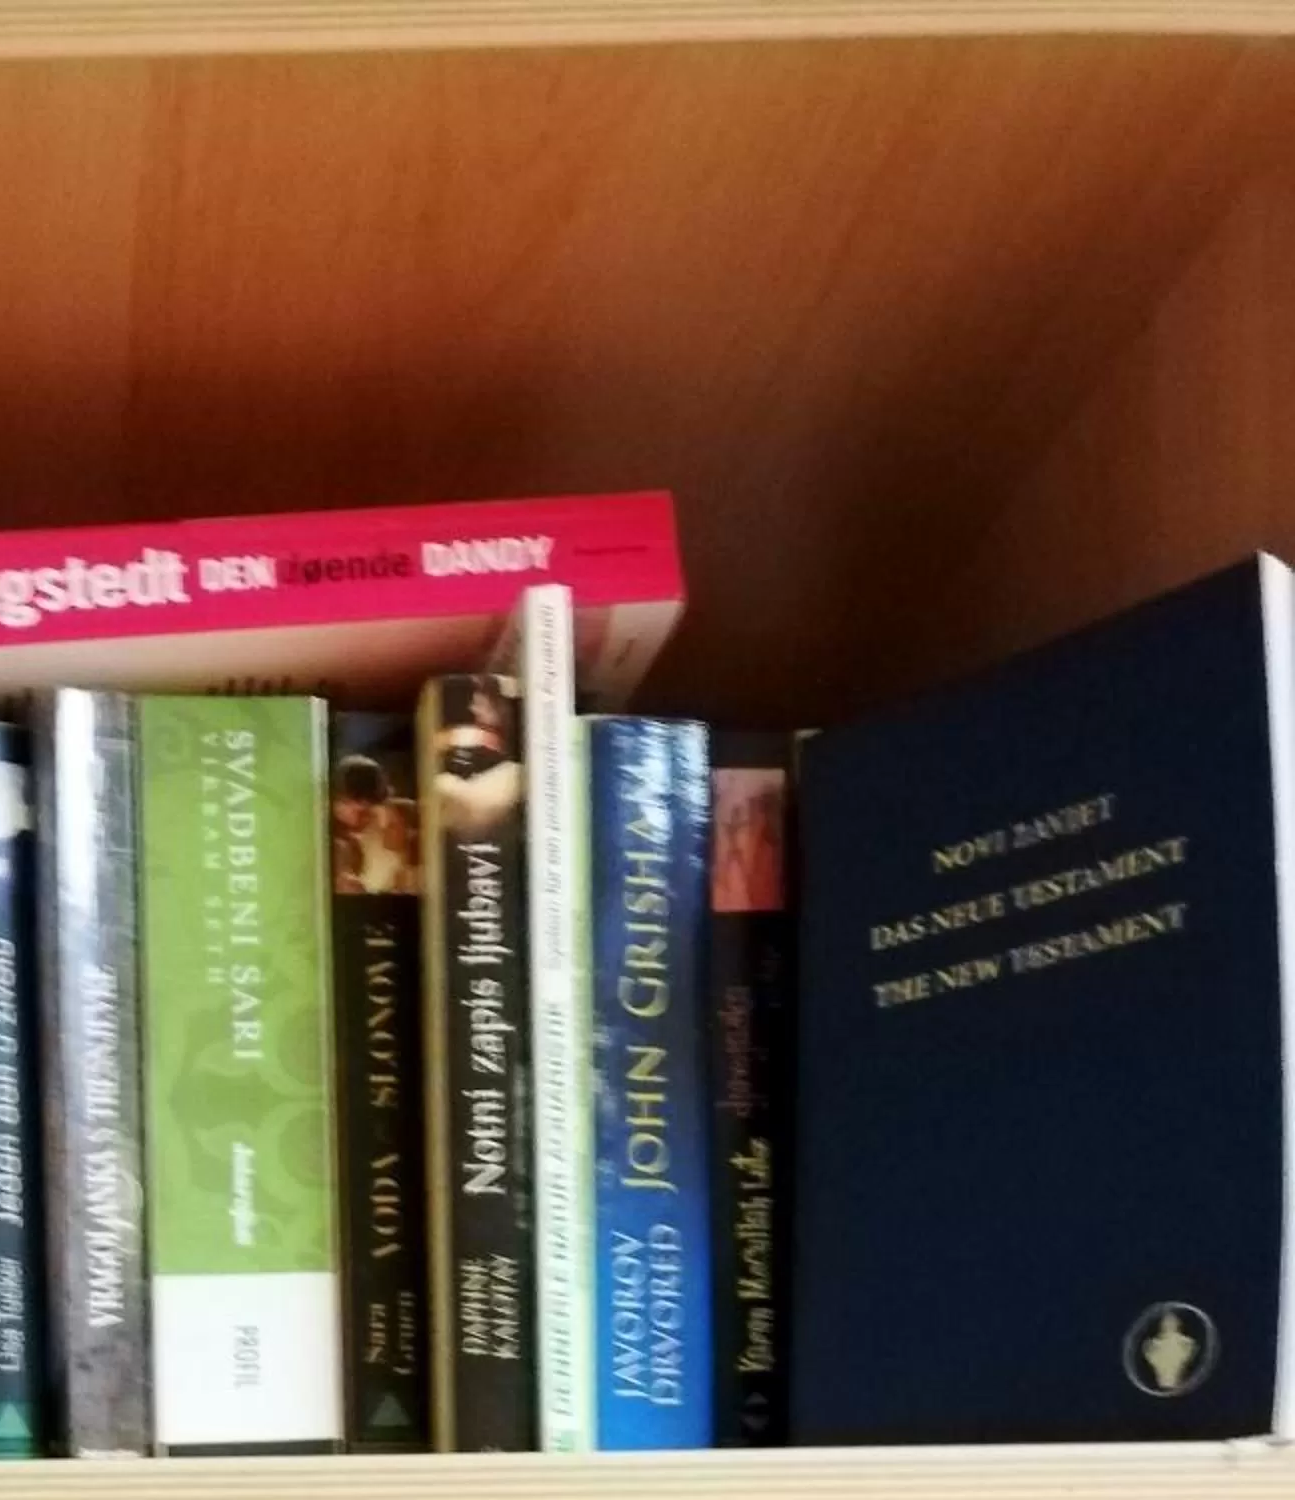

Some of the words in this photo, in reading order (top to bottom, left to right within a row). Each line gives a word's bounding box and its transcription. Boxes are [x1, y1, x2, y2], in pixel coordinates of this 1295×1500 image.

[198, 555, 277, 591] DEN
[277, 549, 415, 587] døende
[422, 534, 554, 577] DANDY
[224, 730, 262, 947] SVADBENI
[931, 830, 1006, 874] NOVI
[456, 843, 514, 966] ljubavi
[870, 914, 928, 950] DAS
[929, 893, 1006, 933] NEUE
[1009, 836, 1189, 911] TESTAMENT
[872, 973, 933, 1008] THE
[933, 954, 1002, 993] NEW
[1009, 902, 1189, 973] TESTAMENT
[230, 962, 265, 1061] SARI
[459, 976, 517, 1075] zapis
[462, 1088, 508, 1196] Notni
[619, 1045, 679, 1193] JOHN
[369, 1153, 401, 1259] VODA
[232, 1325, 261, 1389] PROFIL
[365, 1303, 388, 1364] Sara
[612, 1230, 650, 1398] JAVOROV
[648, 1224, 685, 1407] DRVORED
